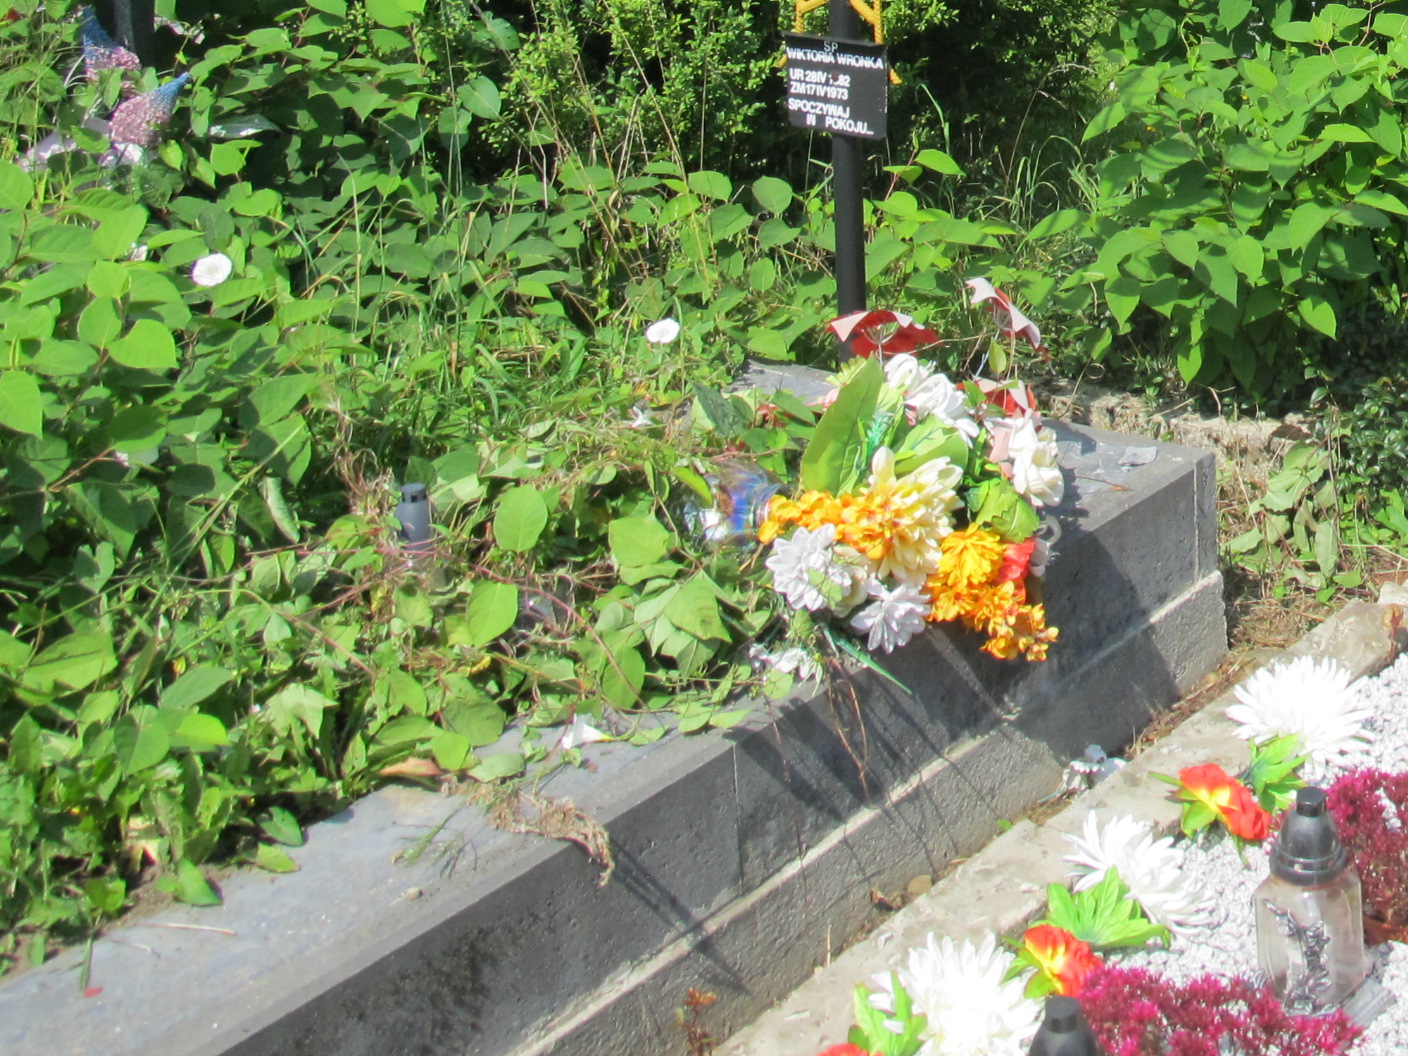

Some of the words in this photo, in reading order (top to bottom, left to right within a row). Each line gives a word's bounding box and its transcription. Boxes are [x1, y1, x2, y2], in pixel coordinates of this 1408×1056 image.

[786, 46, 835, 63] WIKTORIA
[836, 52, 884, 69] WRONKA
[787, 97, 851, 119] SPOCZYWAJ
